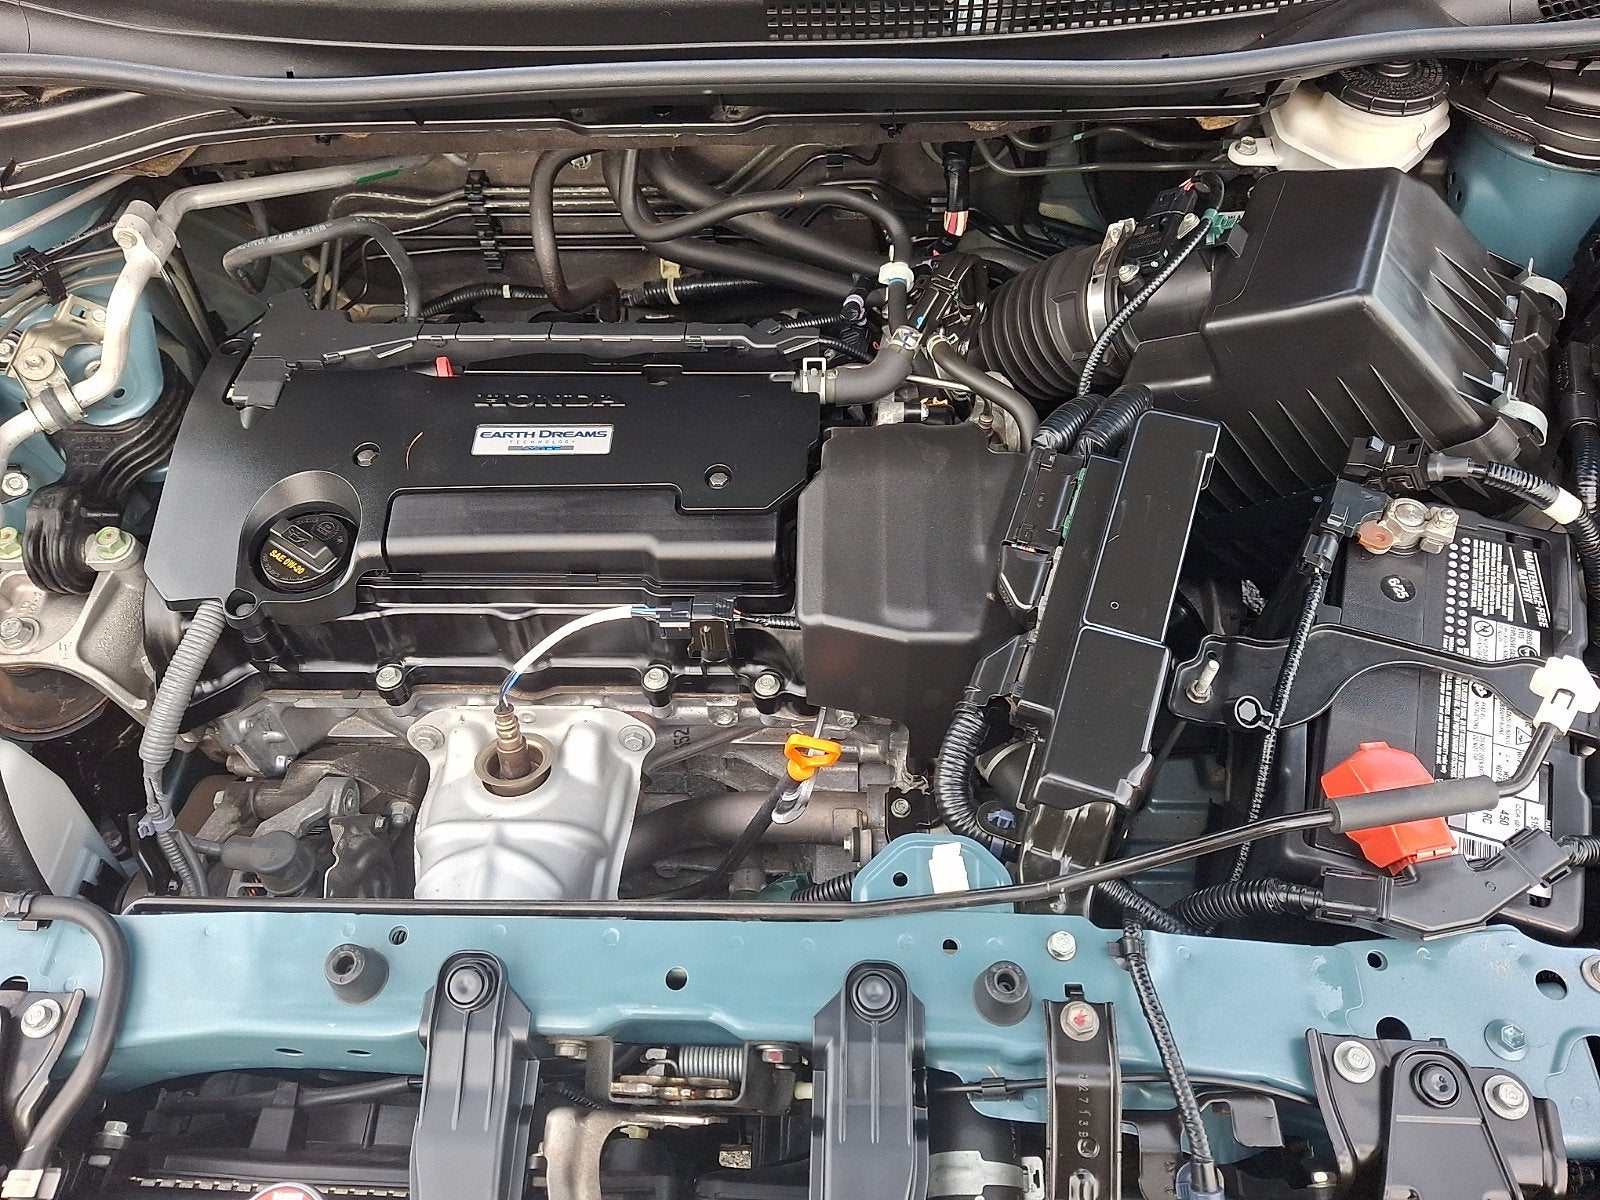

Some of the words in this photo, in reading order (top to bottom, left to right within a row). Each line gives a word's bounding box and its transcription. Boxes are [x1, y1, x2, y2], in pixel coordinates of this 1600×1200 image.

[479, 430, 536, 440] EARTH
[538, 429, 608, 439] DREAMS
[269, 549, 286, 563] SAE
[283, 558, 306, 575] 0W-20
[1388, 577, 1410, 599] 6/25
[1517, 567, 1535, 605] BATTERY
[1500, 809, 1510, 826] 450
